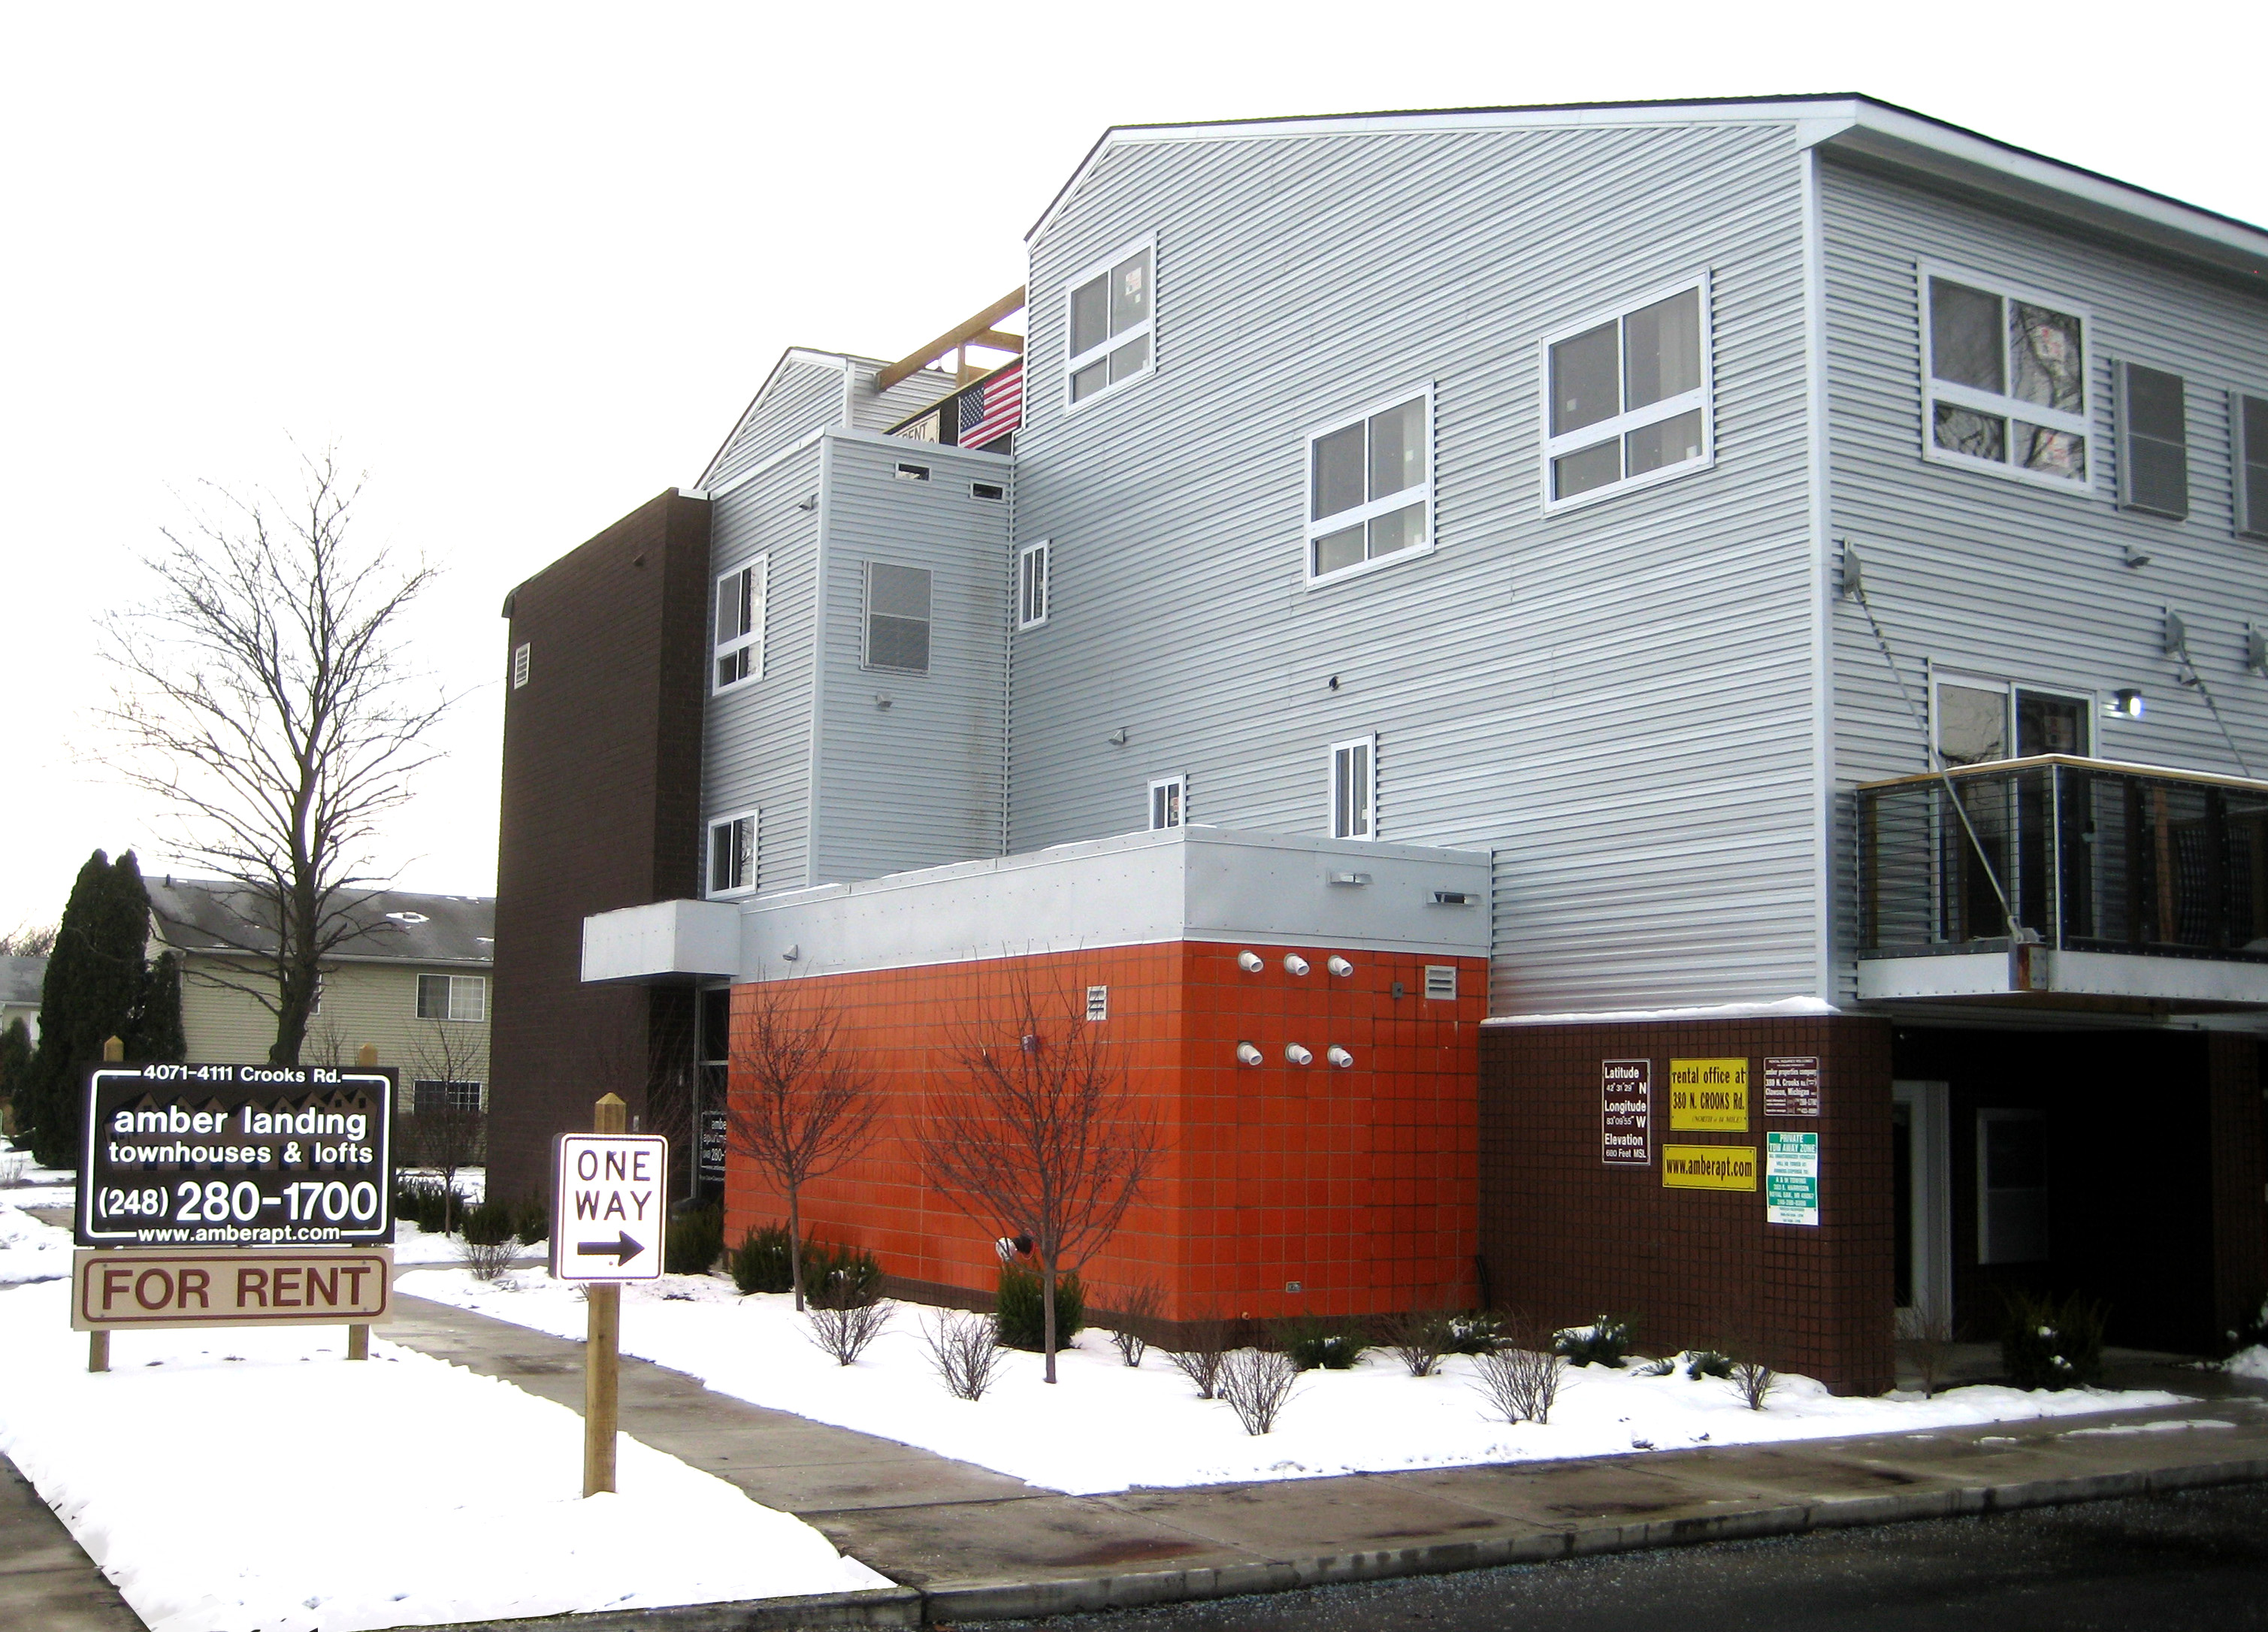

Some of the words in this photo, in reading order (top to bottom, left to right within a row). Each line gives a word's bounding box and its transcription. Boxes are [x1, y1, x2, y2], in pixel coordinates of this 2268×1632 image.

[143, 1065, 233, 1080] 4071-4111
[240, 1067, 306, 1083] Crooks
[313, 1068, 342, 1083] Rd.
[1604, 1066, 1640, 1079] Latitude
[1672, 1067, 1698, 1083] rental
[1704, 1066, 1730, 1083] office
[1735, 1067, 1745, 1083] at
[1639, 1082, 1647, 1094] N
[1604, 1100, 1647, 1114] Longitude
[1673, 1092, 1686, 1109] 380
[1690, 1093, 1697, 1109] N.
[1701, 1092, 1730, 1110] CROOKS
[1733, 1093, 1745, 1110] Rd.
[114, 1105, 228, 1133] amber
[243, 1106, 367, 1141] landing
[1636, 1116, 1647, 1128] W
[1604, 1133, 1644, 1146] Elevation
[1780, 1134, 1804, 1143] PRIVATE
[109, 1141, 271, 1163] townhouses
[283, 1144, 302, 1162] &
[315, 1142, 373, 1163] lofts
[1618, 1148, 1631, 1158] Feet
[1633, 1149, 1647, 1158] MSL
[578, 1150, 650, 1181] ONE
[1666, 1154, 1752, 1181] www.amberapt.com
[99, 1186, 168, 1218] (248)
[176, 1180, 377, 1222] 280-1700
[576, 1190, 652, 1221] WAY
[138, 1226, 340, 1244] www.amberapt.com
[103, 1268, 210, 1310] FOR
[237, 1266, 371, 1307] RENT
